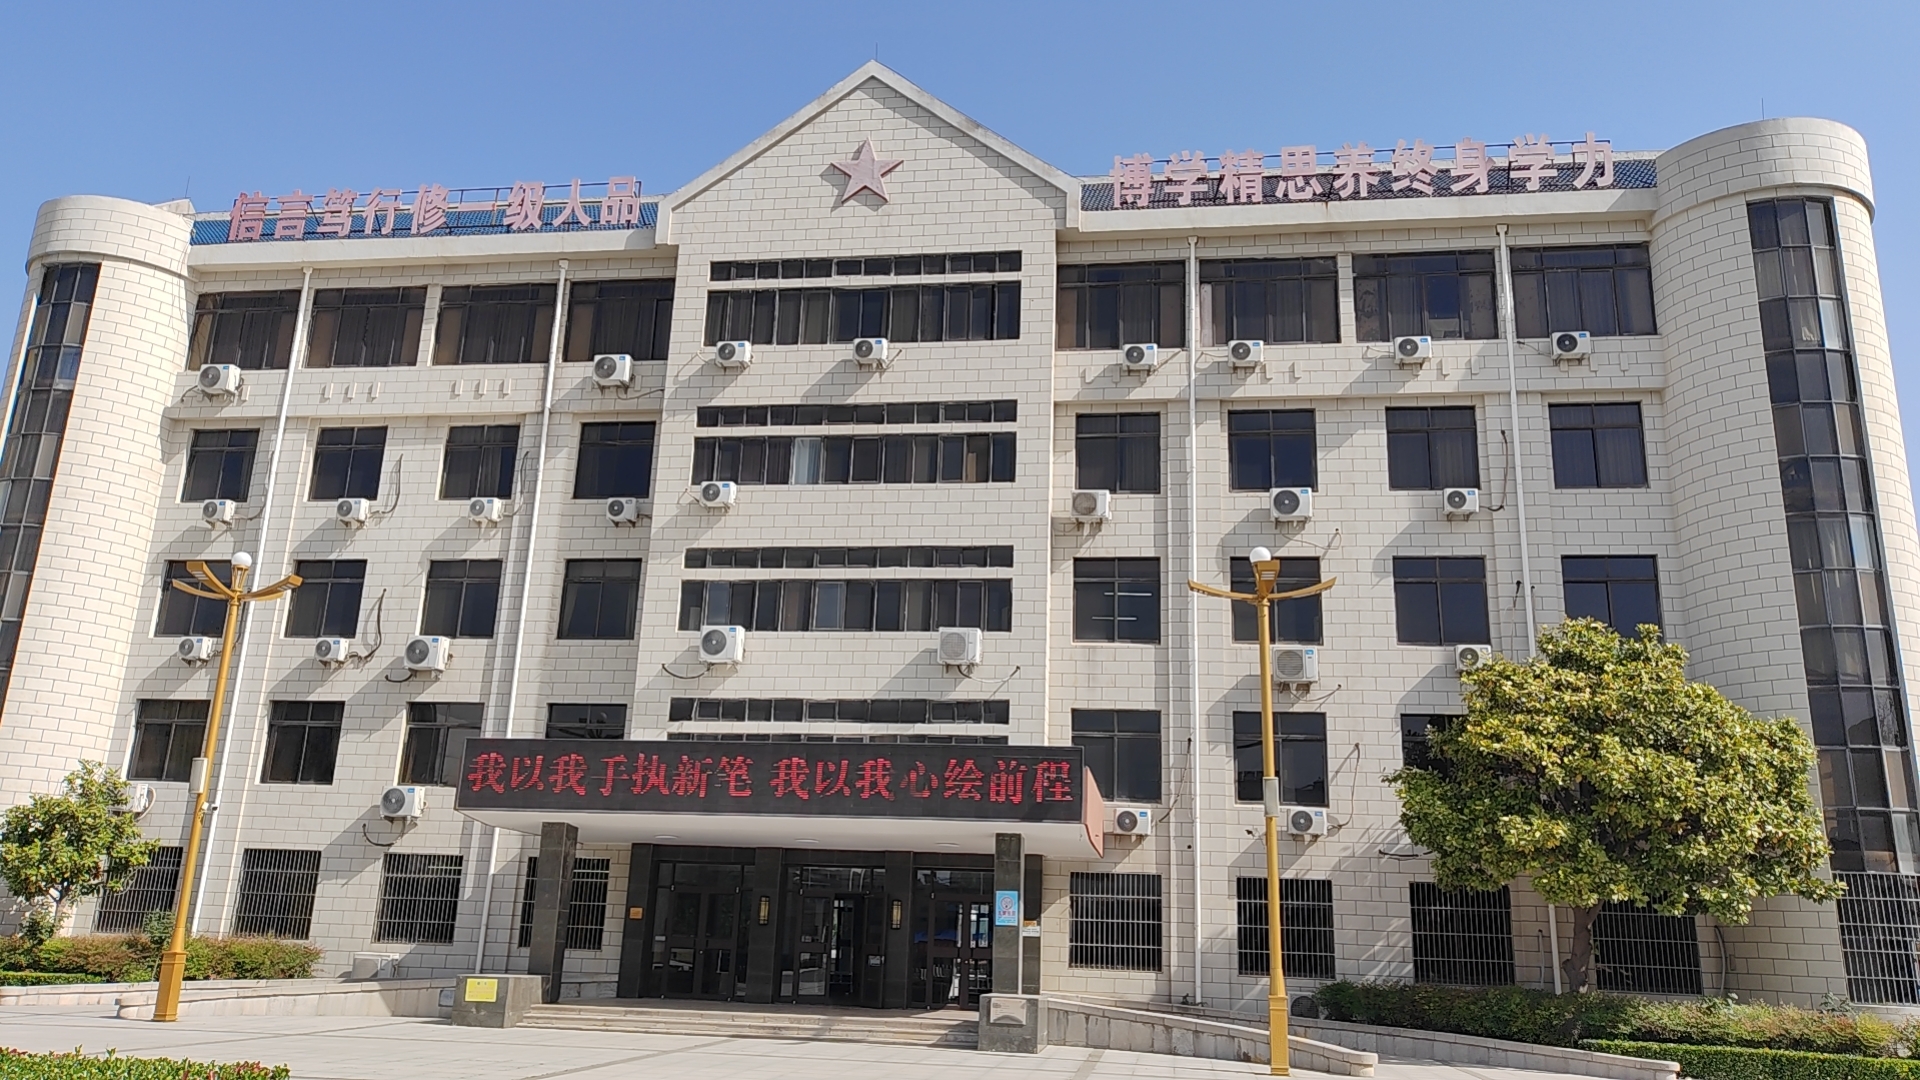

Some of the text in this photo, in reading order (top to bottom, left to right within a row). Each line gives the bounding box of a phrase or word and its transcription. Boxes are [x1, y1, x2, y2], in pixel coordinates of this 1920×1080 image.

[1110, 132, 1616, 208] 博学精思养终身学力
[228, 175, 641, 242] 信言笃行修一级人品
[467, 752, 1074, 804] 我以我手执新笔 我以我心绘前程
